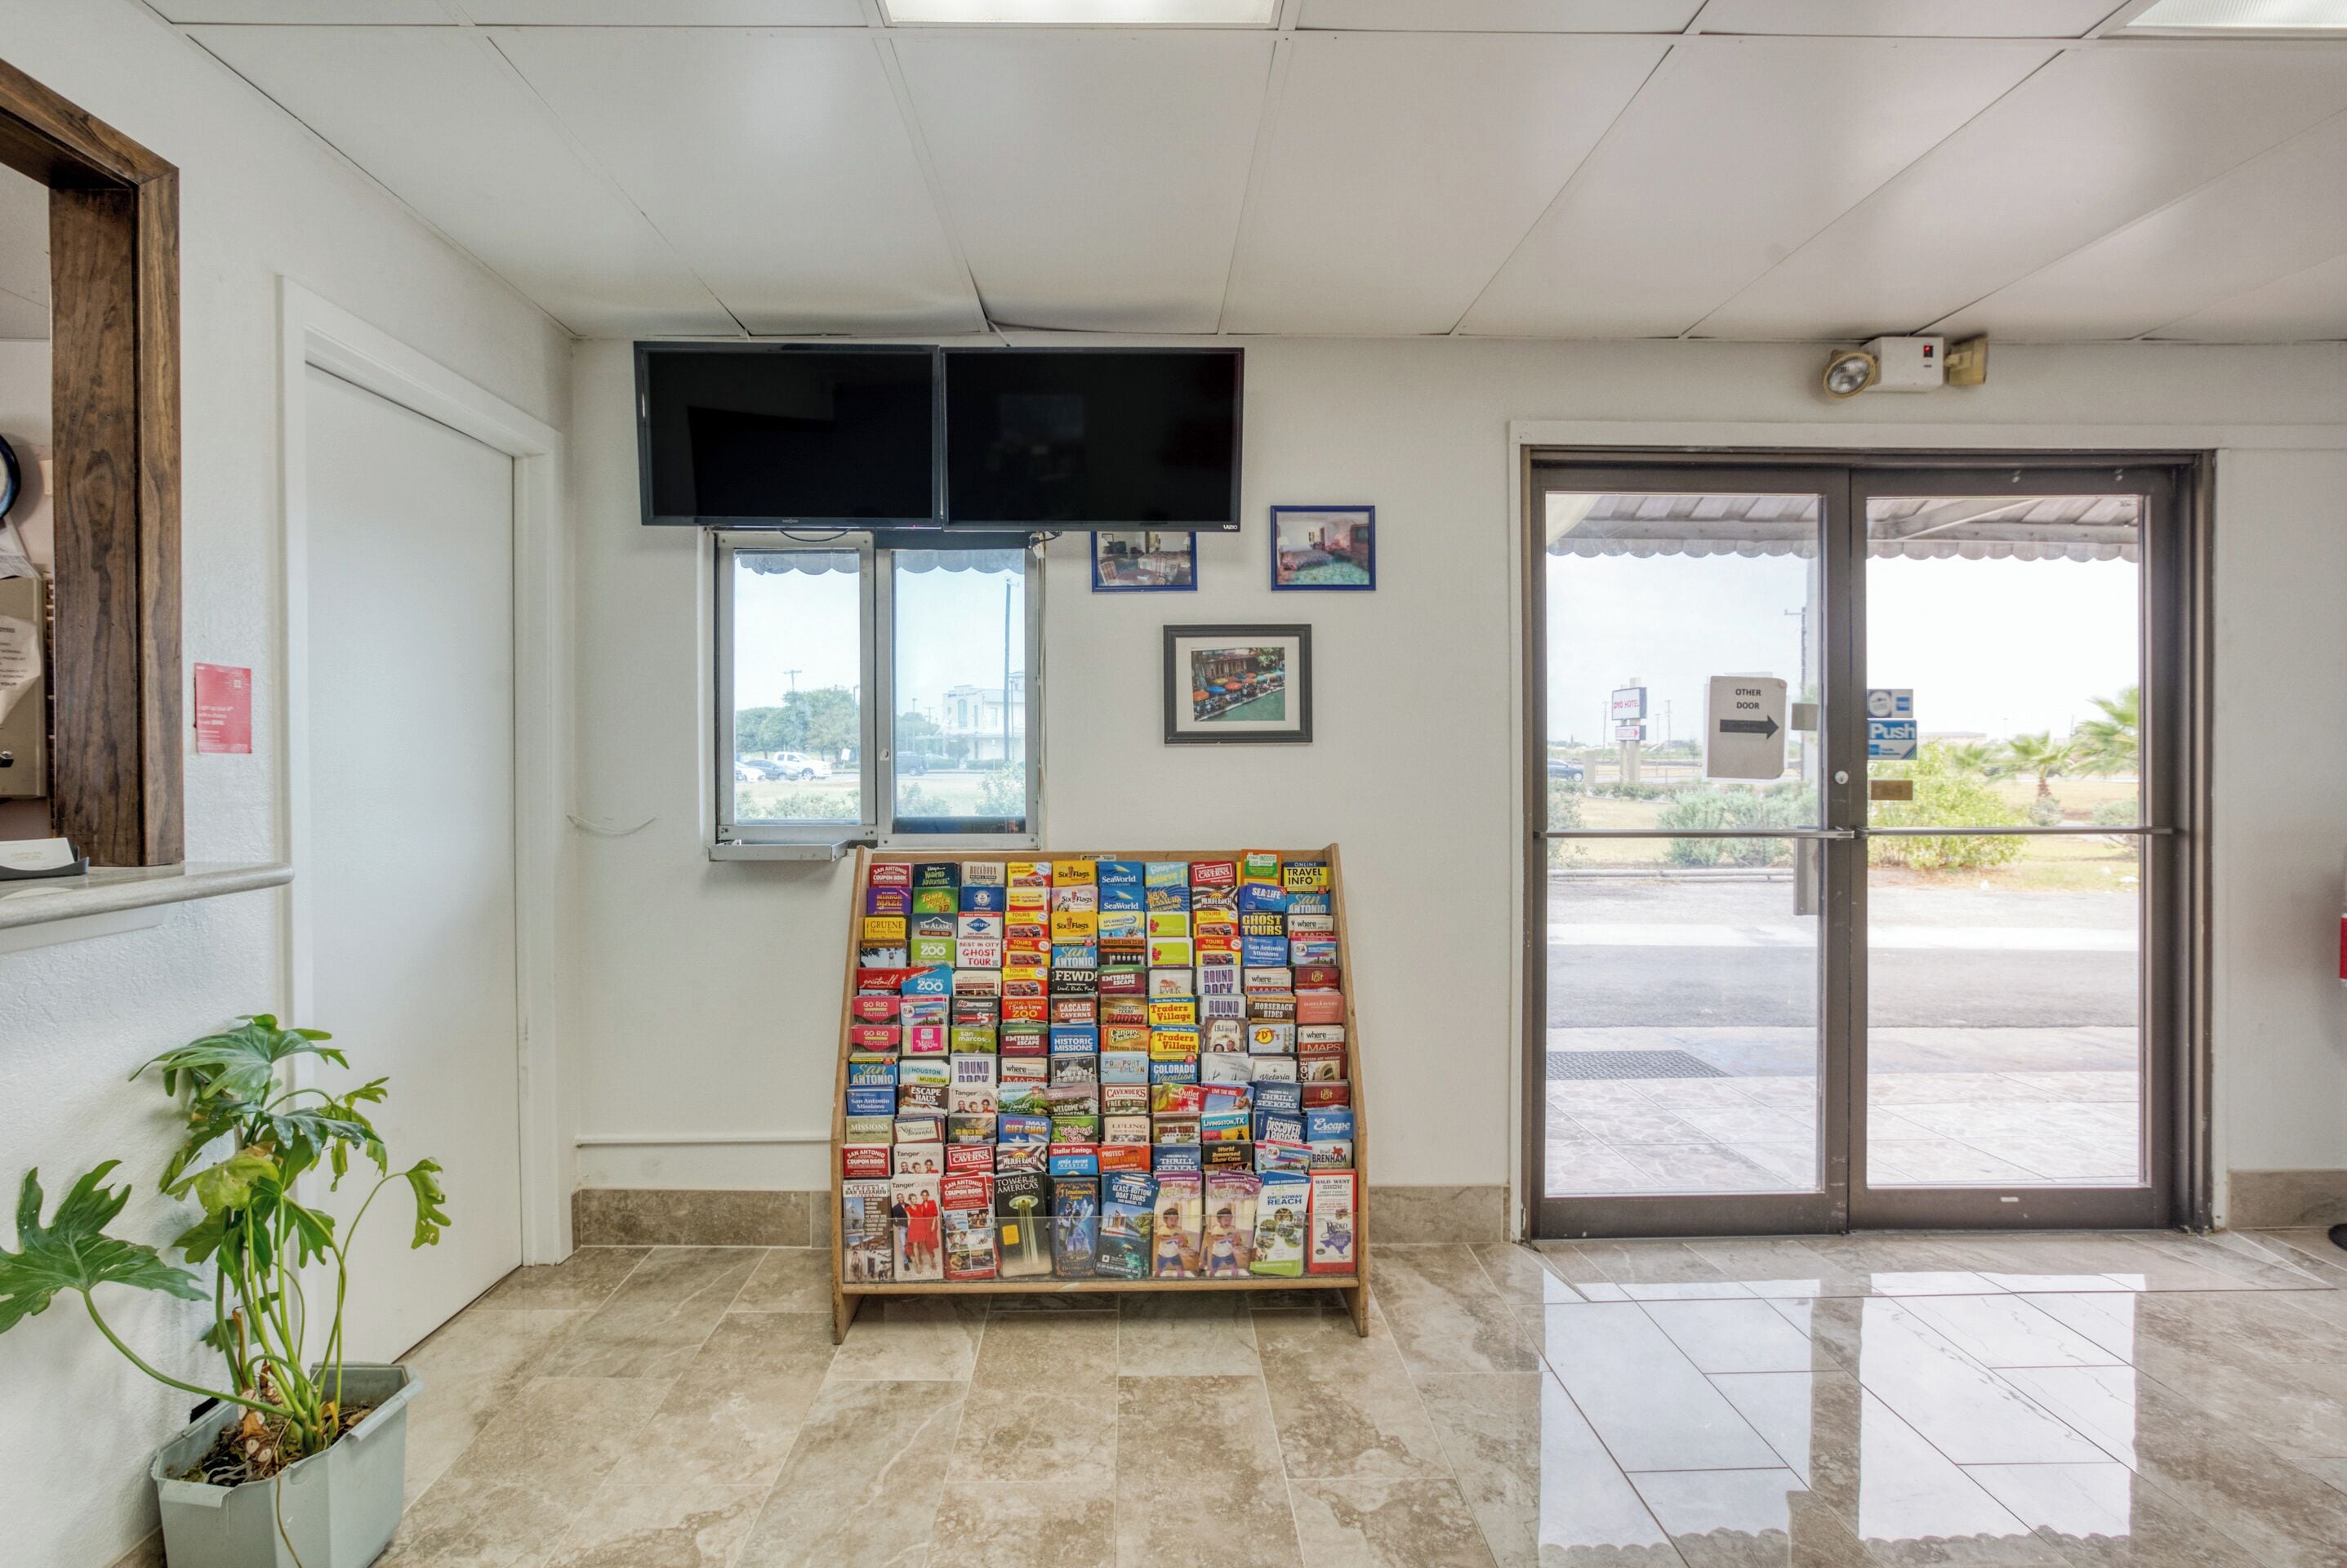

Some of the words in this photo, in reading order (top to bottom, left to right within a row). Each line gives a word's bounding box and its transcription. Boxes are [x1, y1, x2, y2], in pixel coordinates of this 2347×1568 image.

[1735, 688, 1761, 697] OTHER
[1736, 702, 1760, 710] DOOR
[1871, 723, 1915, 739] Push
[1242, 915, 1282, 925] GHOST
[1242, 925, 1282, 936] TOURS
[921, 947, 946, 955] ZOO
[917, 982, 943, 991] ZOO
[1059, 1004, 1091, 1012] CASCADE
[1254, 1002, 1294, 1010] HORSEBACK
[1157, 1013, 1191, 1021] Village
[1157, 1033, 1194, 1041] Traders
[1163, 1041, 1196, 1050] Village
[1154, 1065, 1195, 1073] COLORADO
[911, 1087, 941, 1096] ESCAPE
[1107, 1089, 1146, 1097] CAVENDER'S
[1261, 1094, 1294, 1102] THRILL
[1257, 1100, 1297, 1108] SEEKERS
[1005, 1125, 1024, 1134] GIFT
[1025, 1125, 1047, 1134] SHOP
[1313, 1117, 1351, 1134] Escape
[861, 1149, 885, 1158] ANTONIO
[1312, 1154, 1346, 1163] BRENHAM
[957, 1180, 983, 1189] ANTONIO
[997, 1183, 1039, 1193] AMERICAS
[1112, 1185, 1151, 1196] GLASS-BOTTOM
[1130, 1194, 1146, 1202] TOURS
